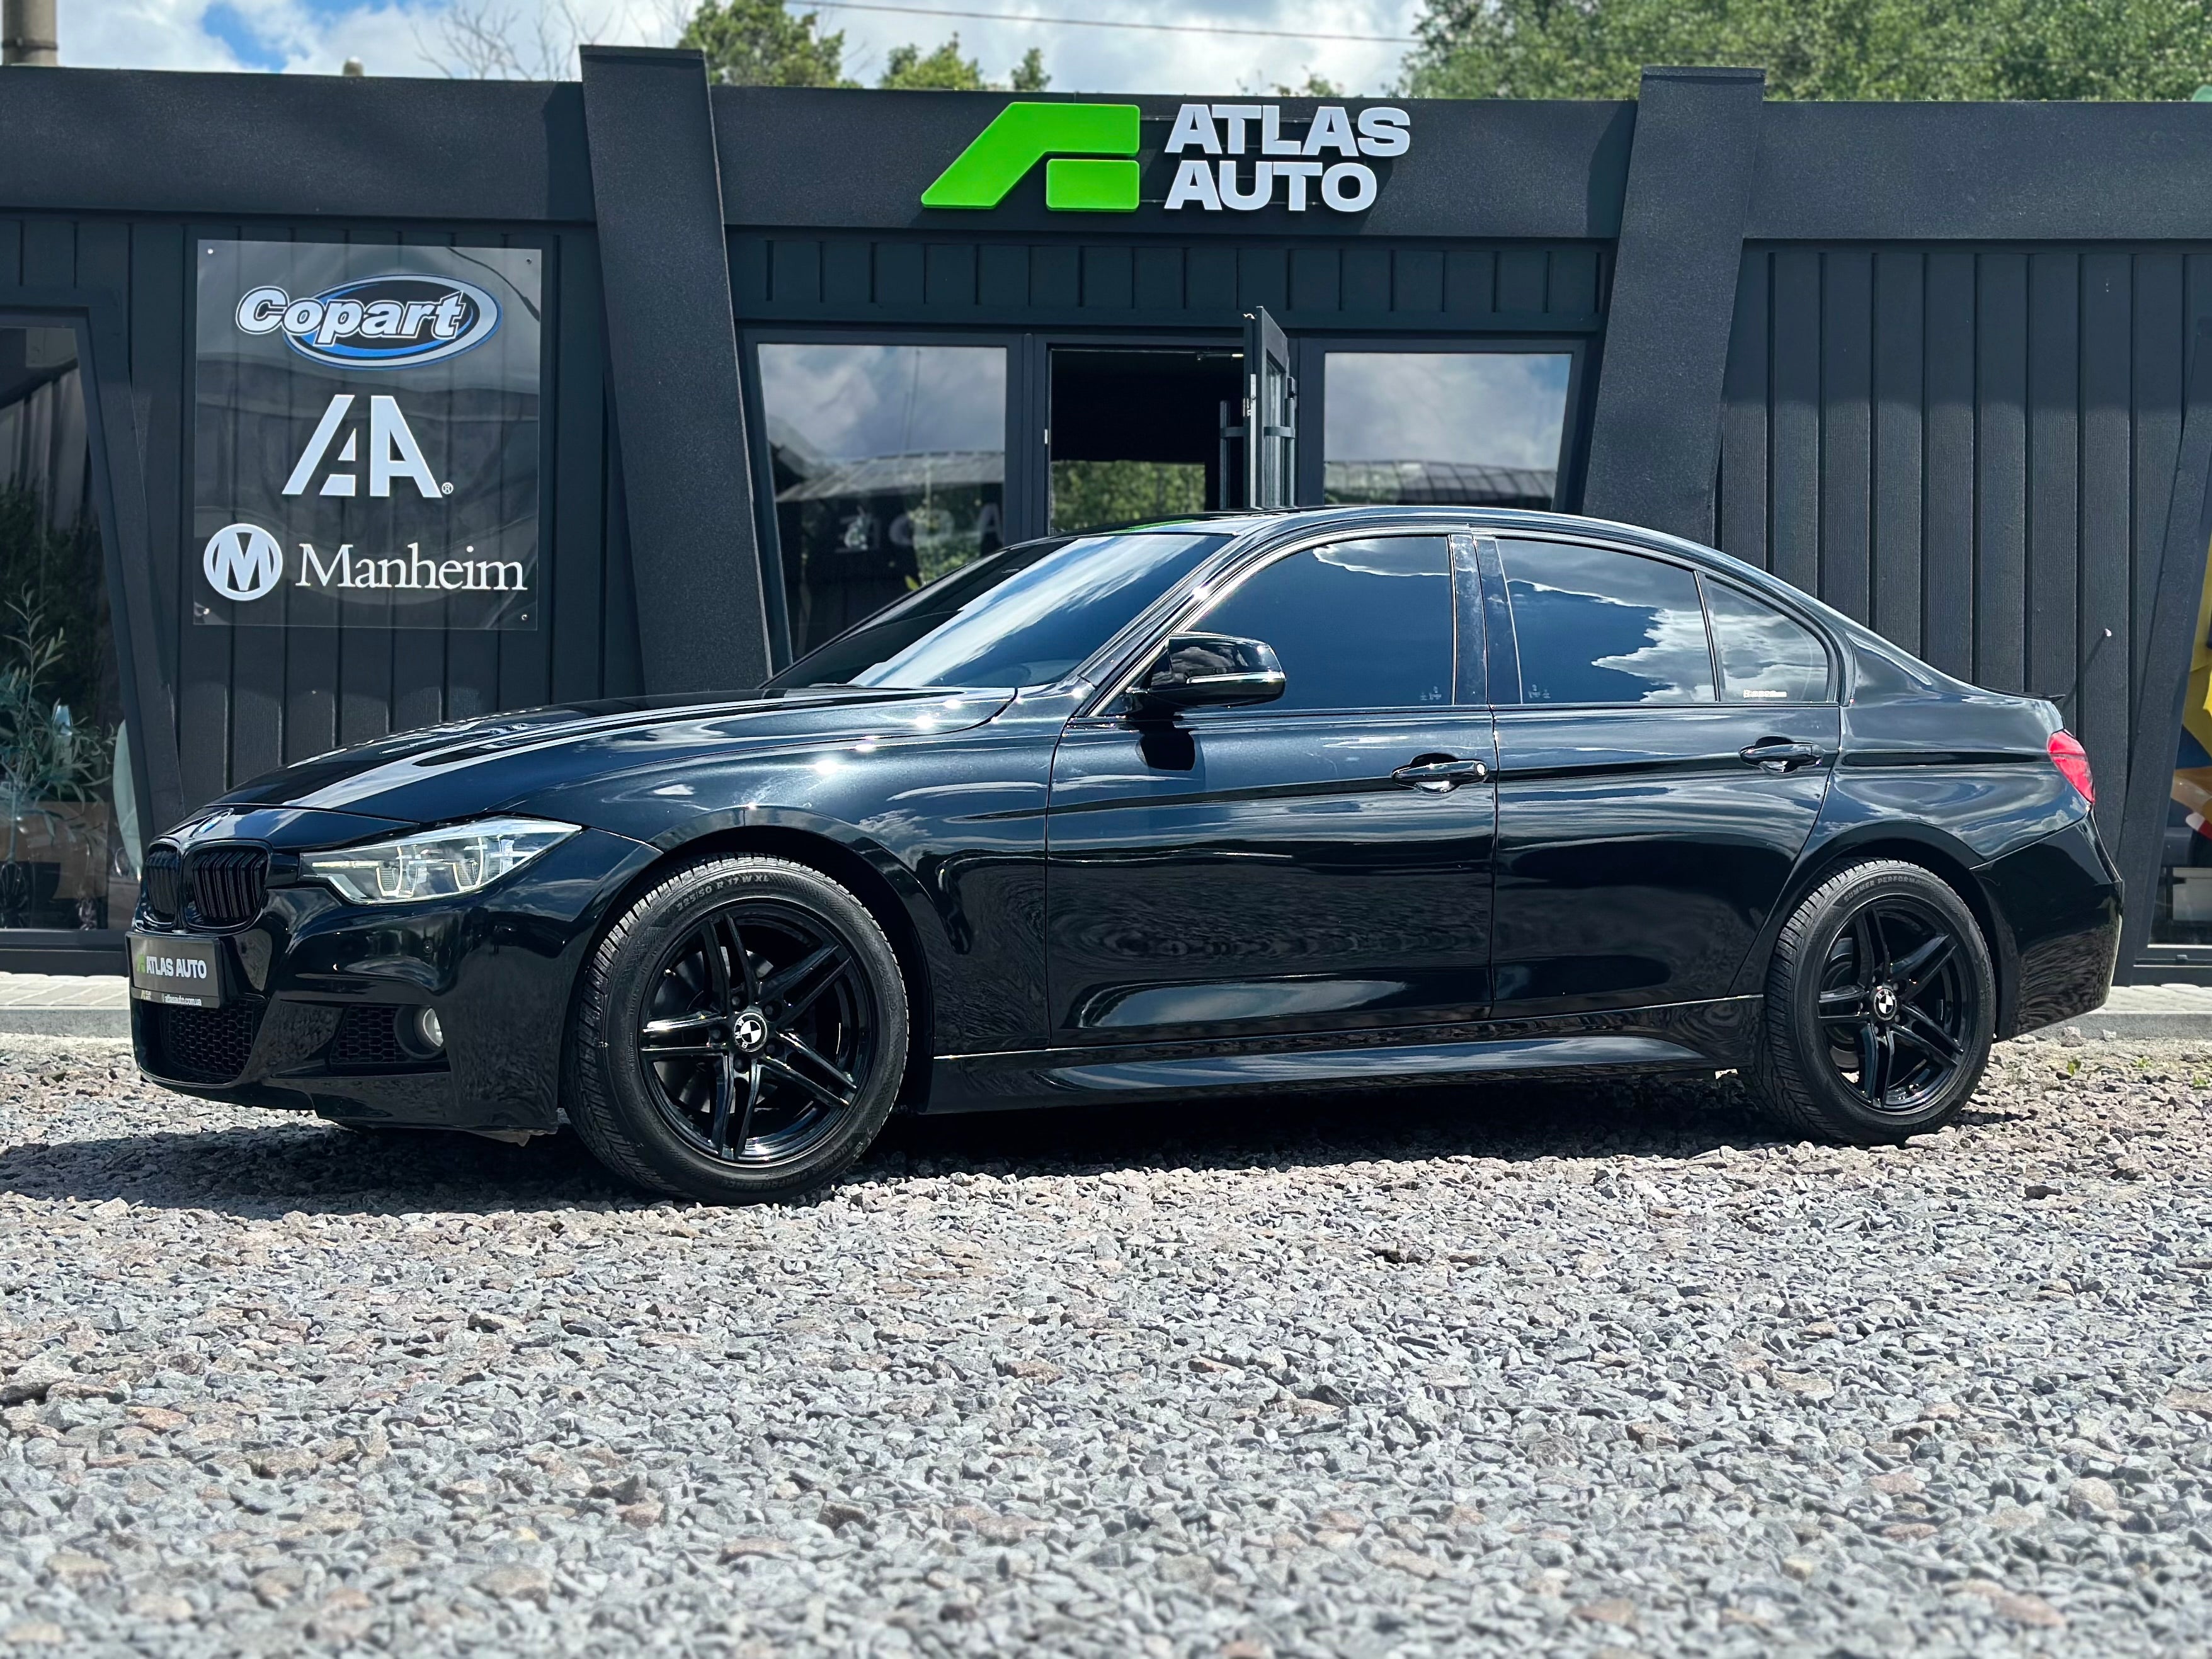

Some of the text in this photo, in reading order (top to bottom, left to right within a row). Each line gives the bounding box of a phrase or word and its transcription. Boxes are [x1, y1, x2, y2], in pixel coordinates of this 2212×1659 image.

[1164, 103, 1411, 158] ATLAS
[1163, 159, 1378, 213] AUTO
[236, 285, 464, 347] Copart
[294, 542, 528, 591] Manheim
[717, 881, 724, 890] R
[728, 876, 739, 886] 17
[742, 875, 753, 883] W
[756, 874, 769, 882] XL
[1843, 880, 1875, 903] SUMMER
[146, 955, 207, 979] ATLAS AUTO
